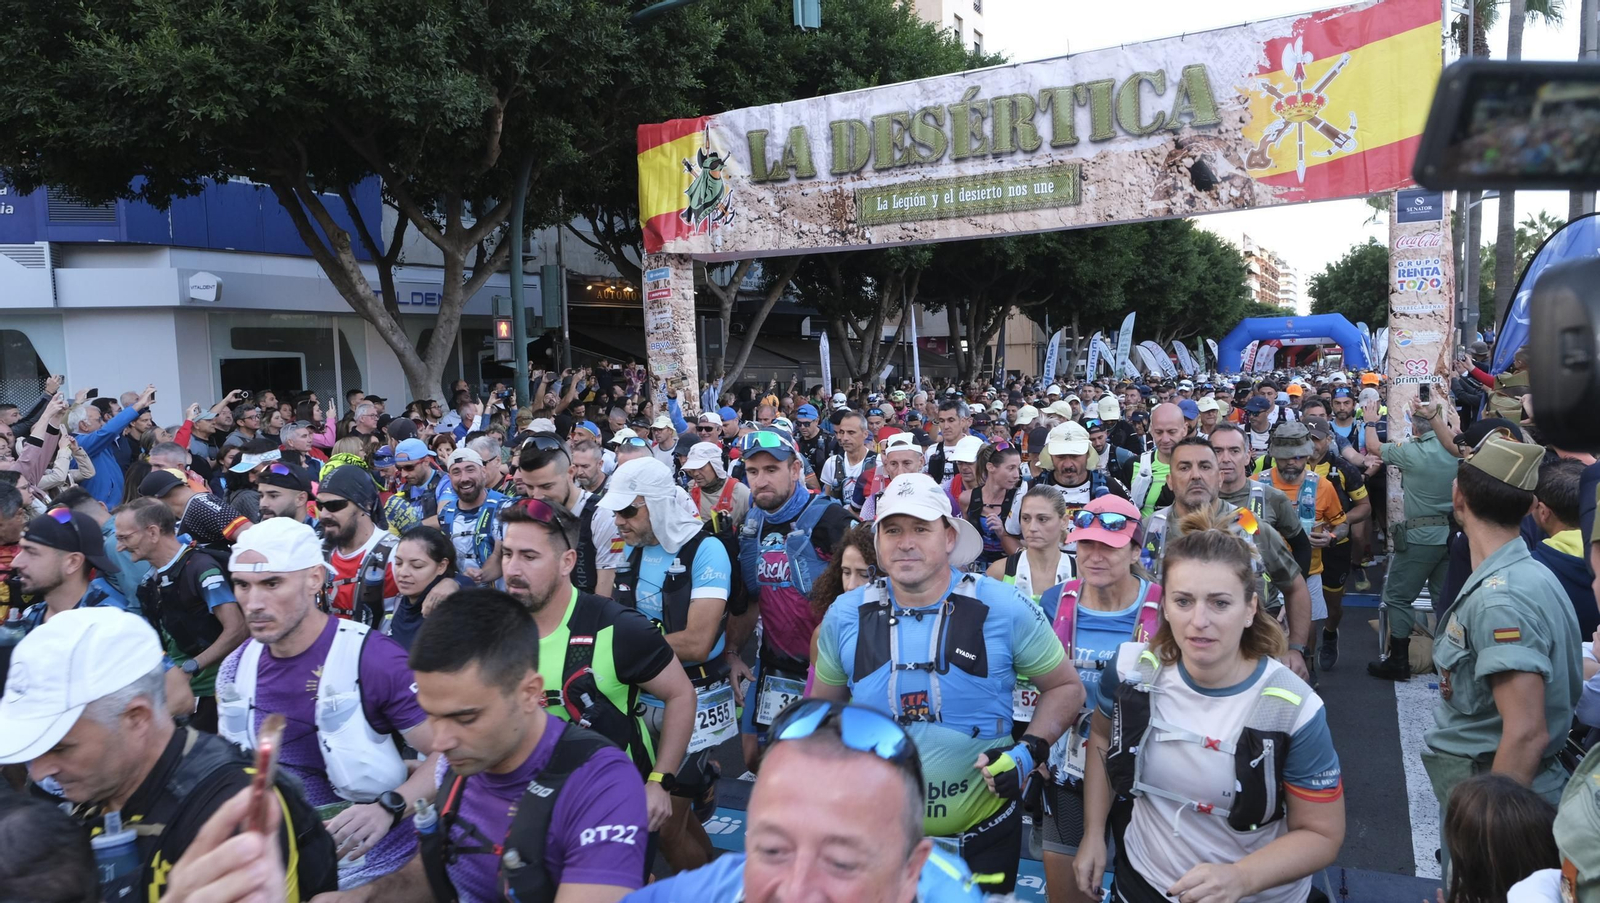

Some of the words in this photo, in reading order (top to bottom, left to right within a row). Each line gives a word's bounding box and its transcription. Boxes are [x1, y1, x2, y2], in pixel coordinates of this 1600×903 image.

[746, 125, 816, 182] LA
[829, 63, 1222, 175] DESÉRTICA
[877, 196, 888, 210] La
[893, 193, 926, 211] Legión
[932, 194, 939, 208] y
[944, 189, 954, 203] el
[958, 185, 1002, 202] desierto
[1008, 184, 1028, 197] nos
[1034, 181, 1054, 195] une
[1406, 205, 1433, 213] SENATOR
[1398, 259, 1440, 268] GRUPO
[1398, 266, 1441, 278] RENTA
[1398, 277, 1441, 292] TODO
[650, 341, 671, 350] BBVA
[1395, 375, 1441, 385] primflor
[697, 703, 730, 730] 2555
[928, 779, 968, 800] bles
[580, 825, 638, 846] RT22
